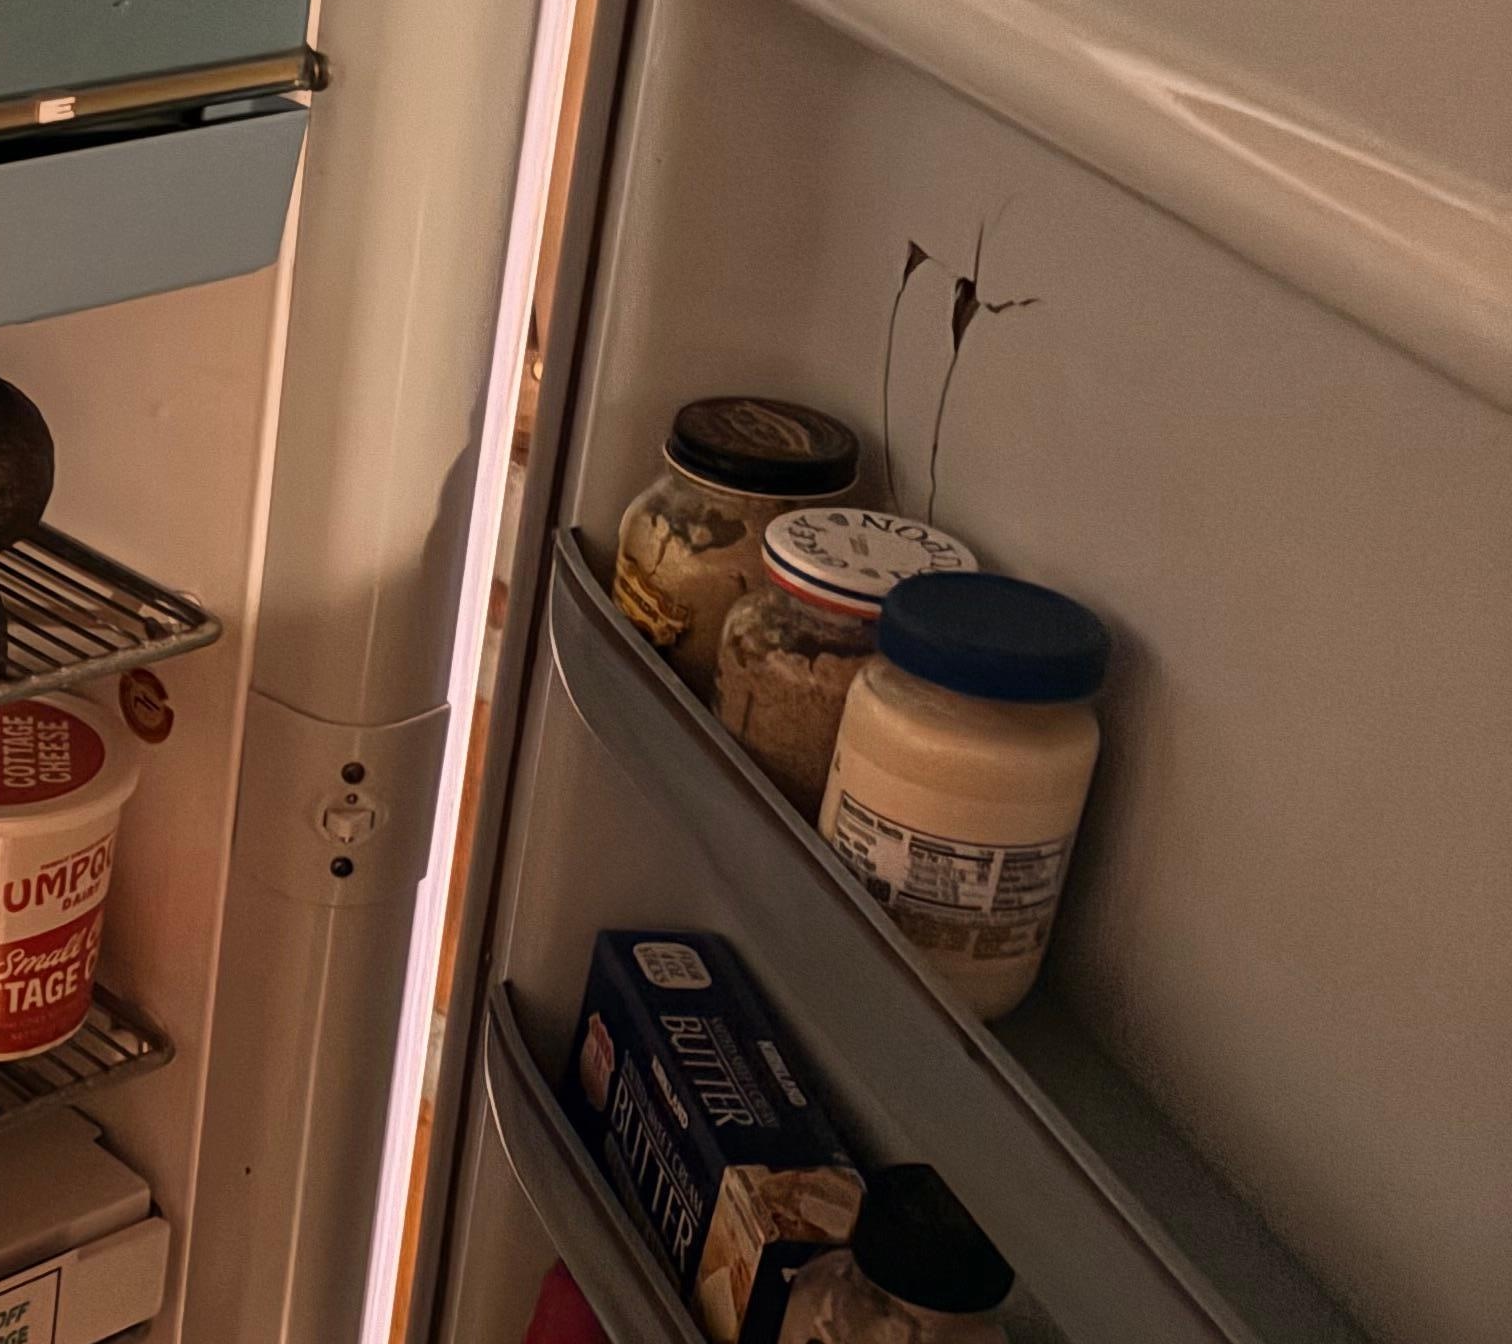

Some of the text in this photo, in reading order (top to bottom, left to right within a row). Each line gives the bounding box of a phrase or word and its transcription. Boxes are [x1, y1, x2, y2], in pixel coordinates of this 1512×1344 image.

[1, 714, 38, 789] COTTAGE
[37, 719, 73, 784] CHEESE
[659, 1013, 756, 1128] BUTTER
[609, 1070, 695, 1274] BUTTER
